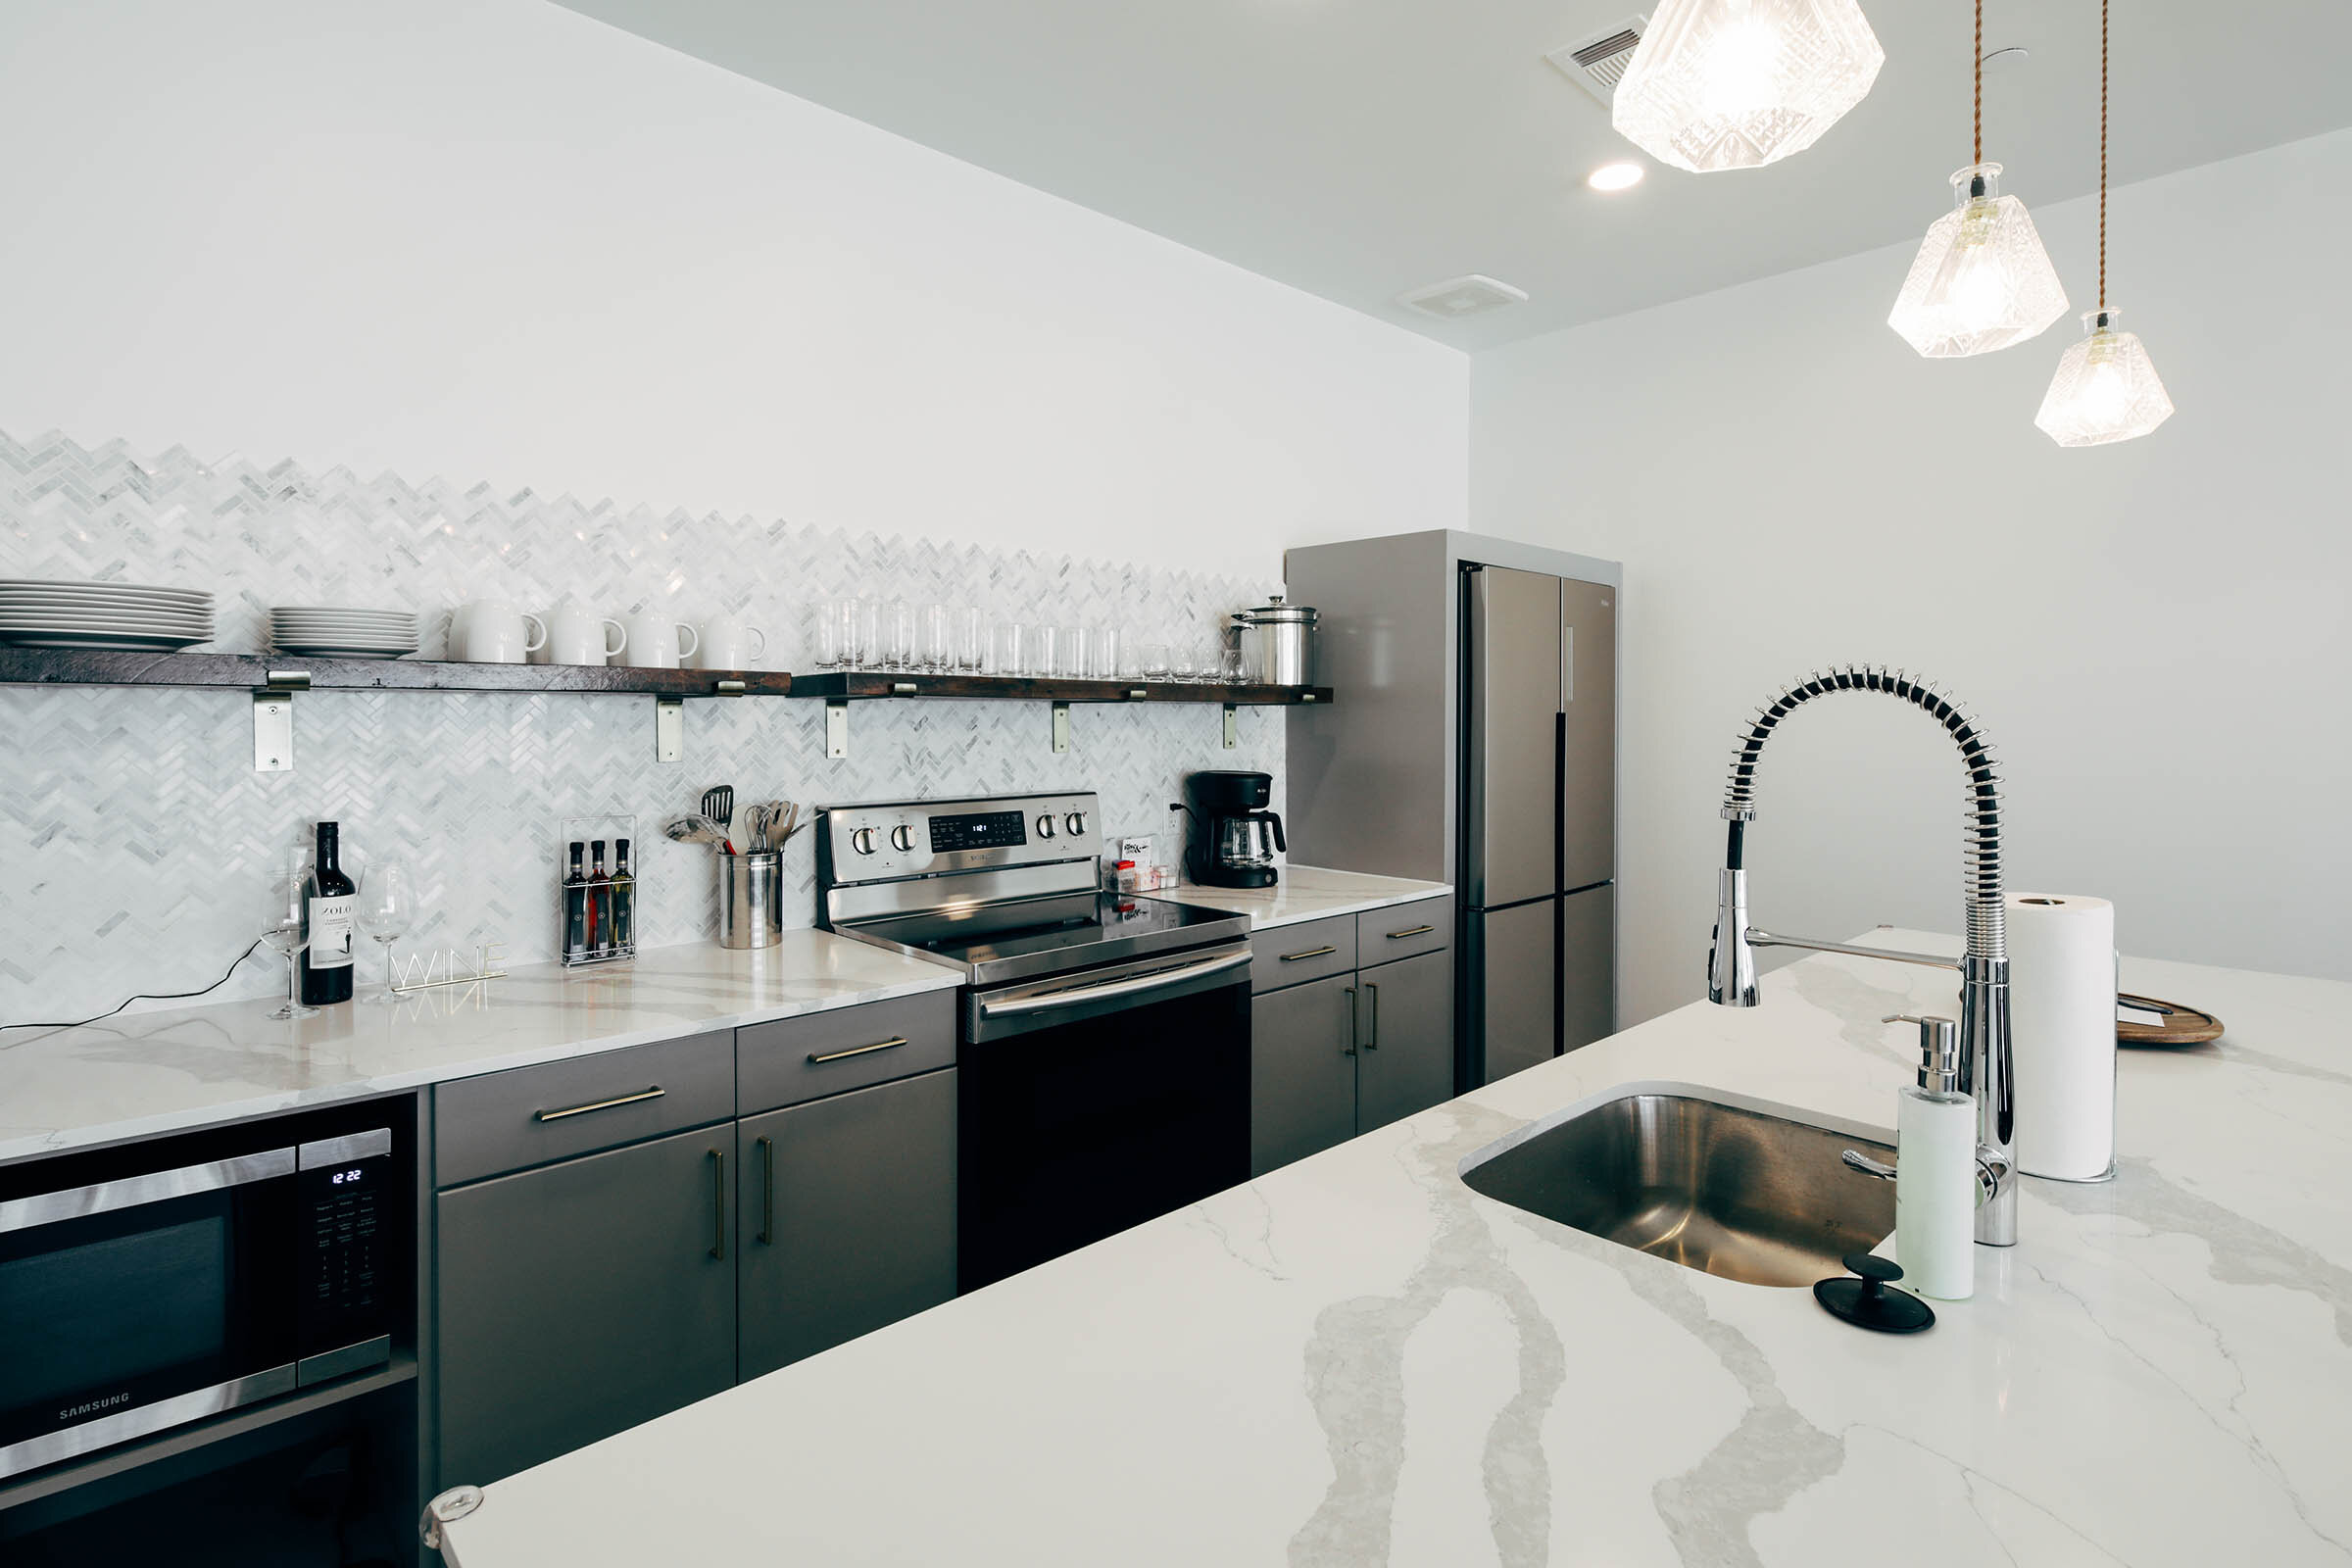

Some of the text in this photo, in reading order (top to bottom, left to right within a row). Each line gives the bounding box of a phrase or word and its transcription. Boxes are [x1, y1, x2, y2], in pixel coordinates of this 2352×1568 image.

[321, 906, 352, 916] ZOLO
[391, 942, 507, 990] WINE
[59, 1392, 129, 1420] SAMSUNG
